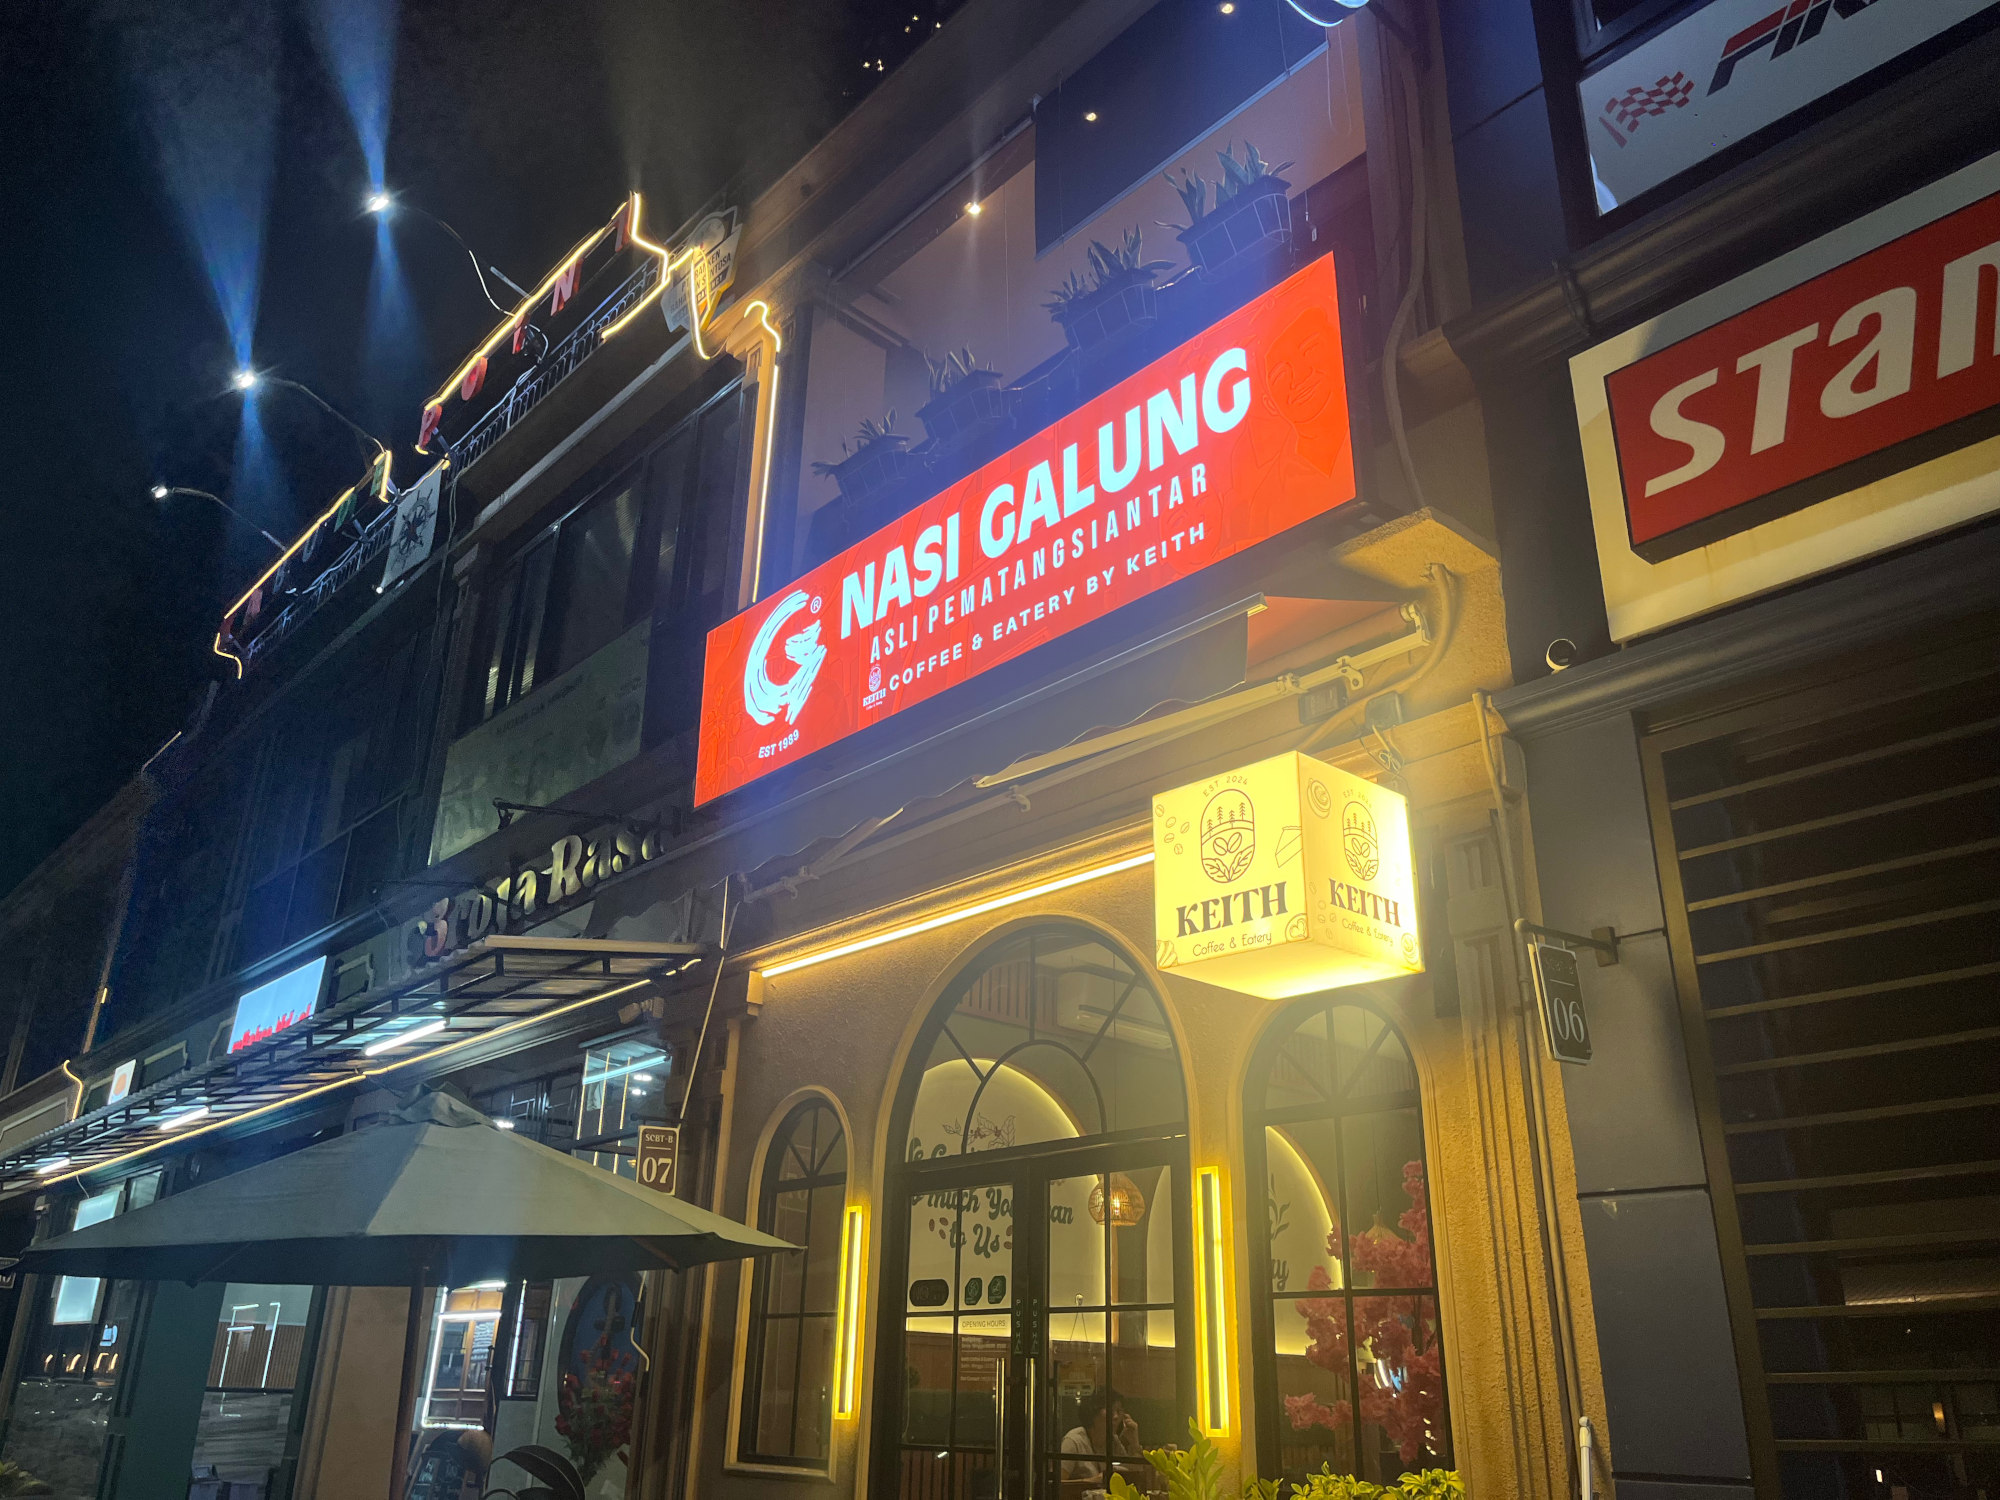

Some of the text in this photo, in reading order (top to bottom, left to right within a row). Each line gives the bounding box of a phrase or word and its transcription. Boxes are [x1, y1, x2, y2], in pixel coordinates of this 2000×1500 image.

[840, 347, 1252, 640] NASI GALUNG
[870, 462, 1207, 663] ASLI PEMATANGSIANTAR
[889, 522, 1206, 691] COFFEE & EATERY BY KEITH
[758, 729, 799, 758] EST 1989
[1202, 775, 1249, 798] EST 2024
[1176, 881, 1289, 938] KEITH
[1329, 878, 1401, 928] KEITH
[1193, 931, 1273, 957] Coffee & Eatery
[1341, 918, 1364, 936] Coffee
[1366, 927, 1372, 937] &
[1553, 997, 1585, 1043] 06
[645, 1133, 675, 1144] SCBT-B
[642, 1156, 673, 1184] 07
[986, 1187, 1014, 1220] Yo
[972, 1223, 1000, 1259] Us
